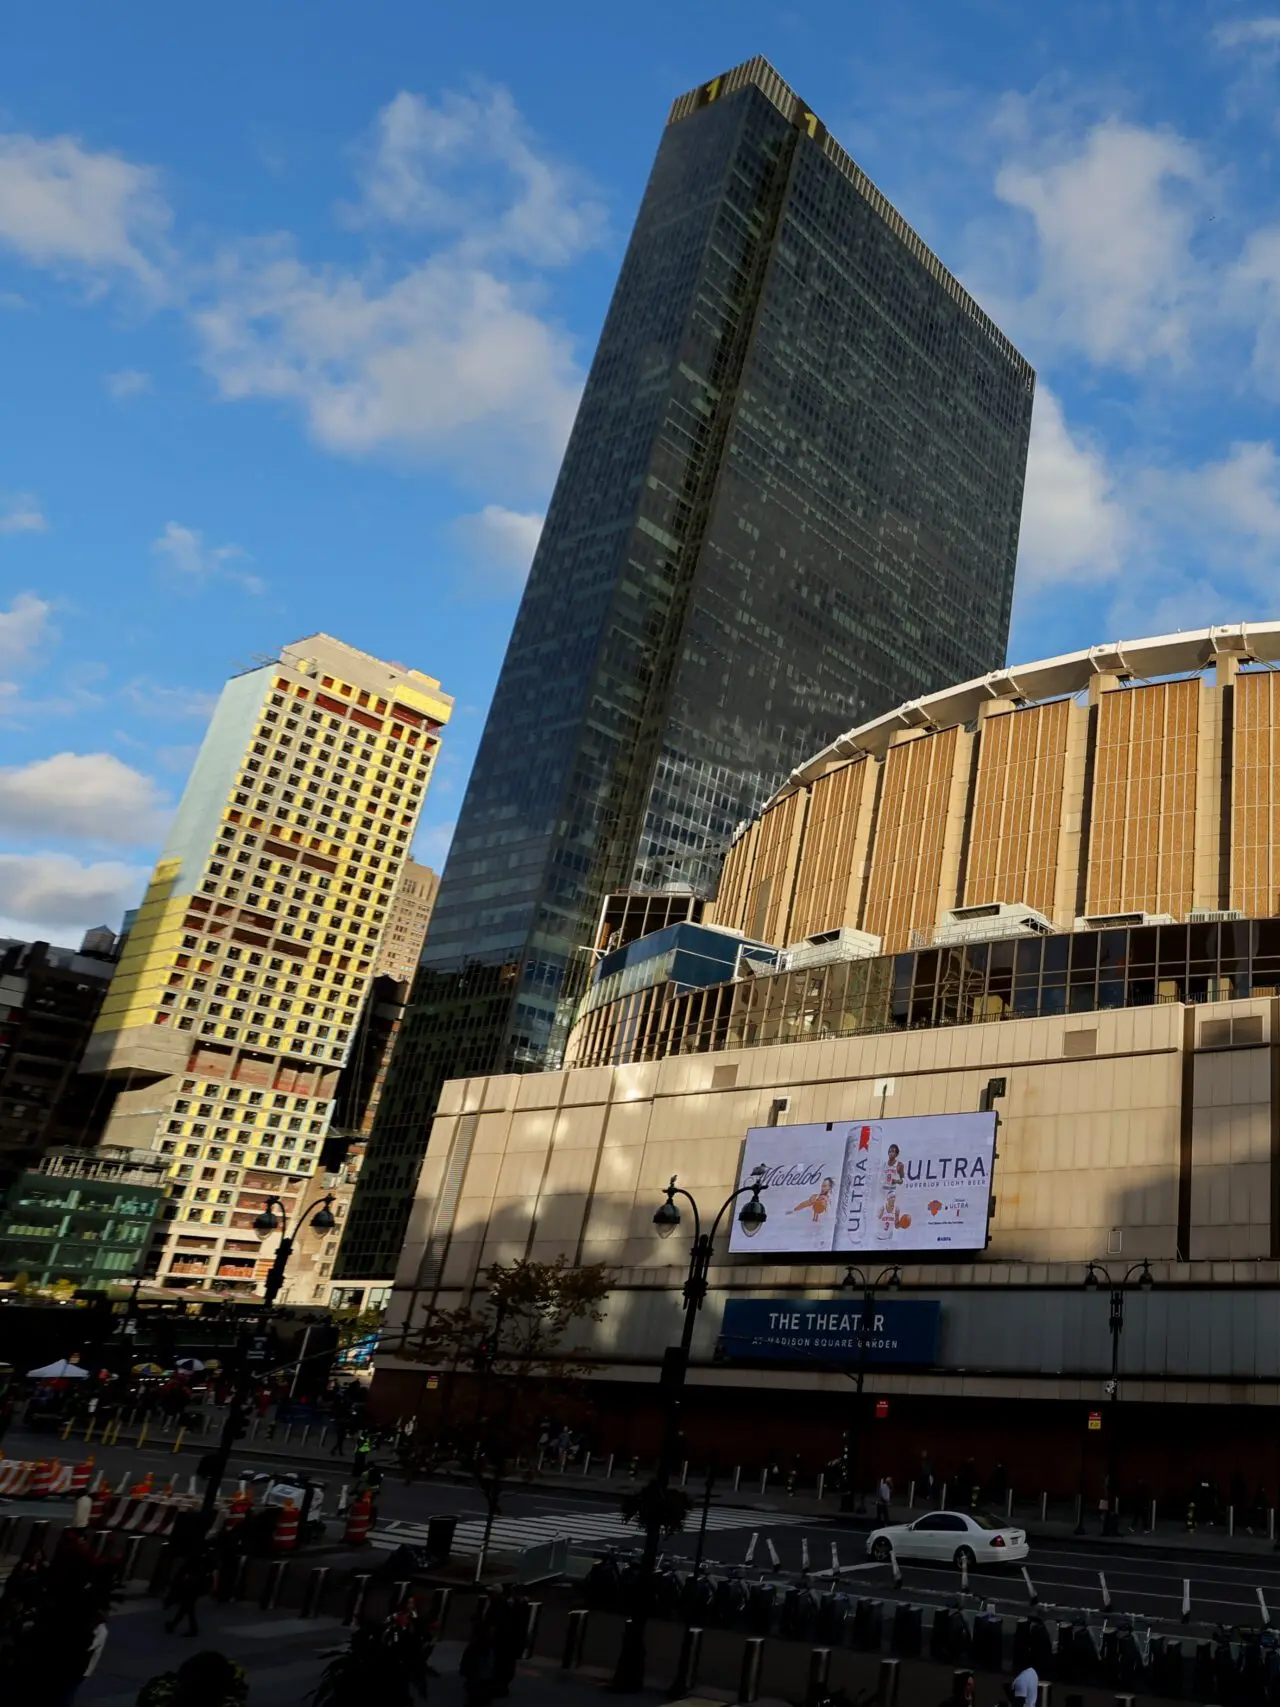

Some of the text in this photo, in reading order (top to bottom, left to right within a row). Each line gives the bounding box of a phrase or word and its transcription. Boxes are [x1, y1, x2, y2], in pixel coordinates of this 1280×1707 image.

[907, 1157, 986, 1180] ULTRA
[848, 1158, 868, 1232] ULTRA
[769, 1313, 885, 1332] THE THEATR
[815, 1338, 853, 1348] SQUARE
